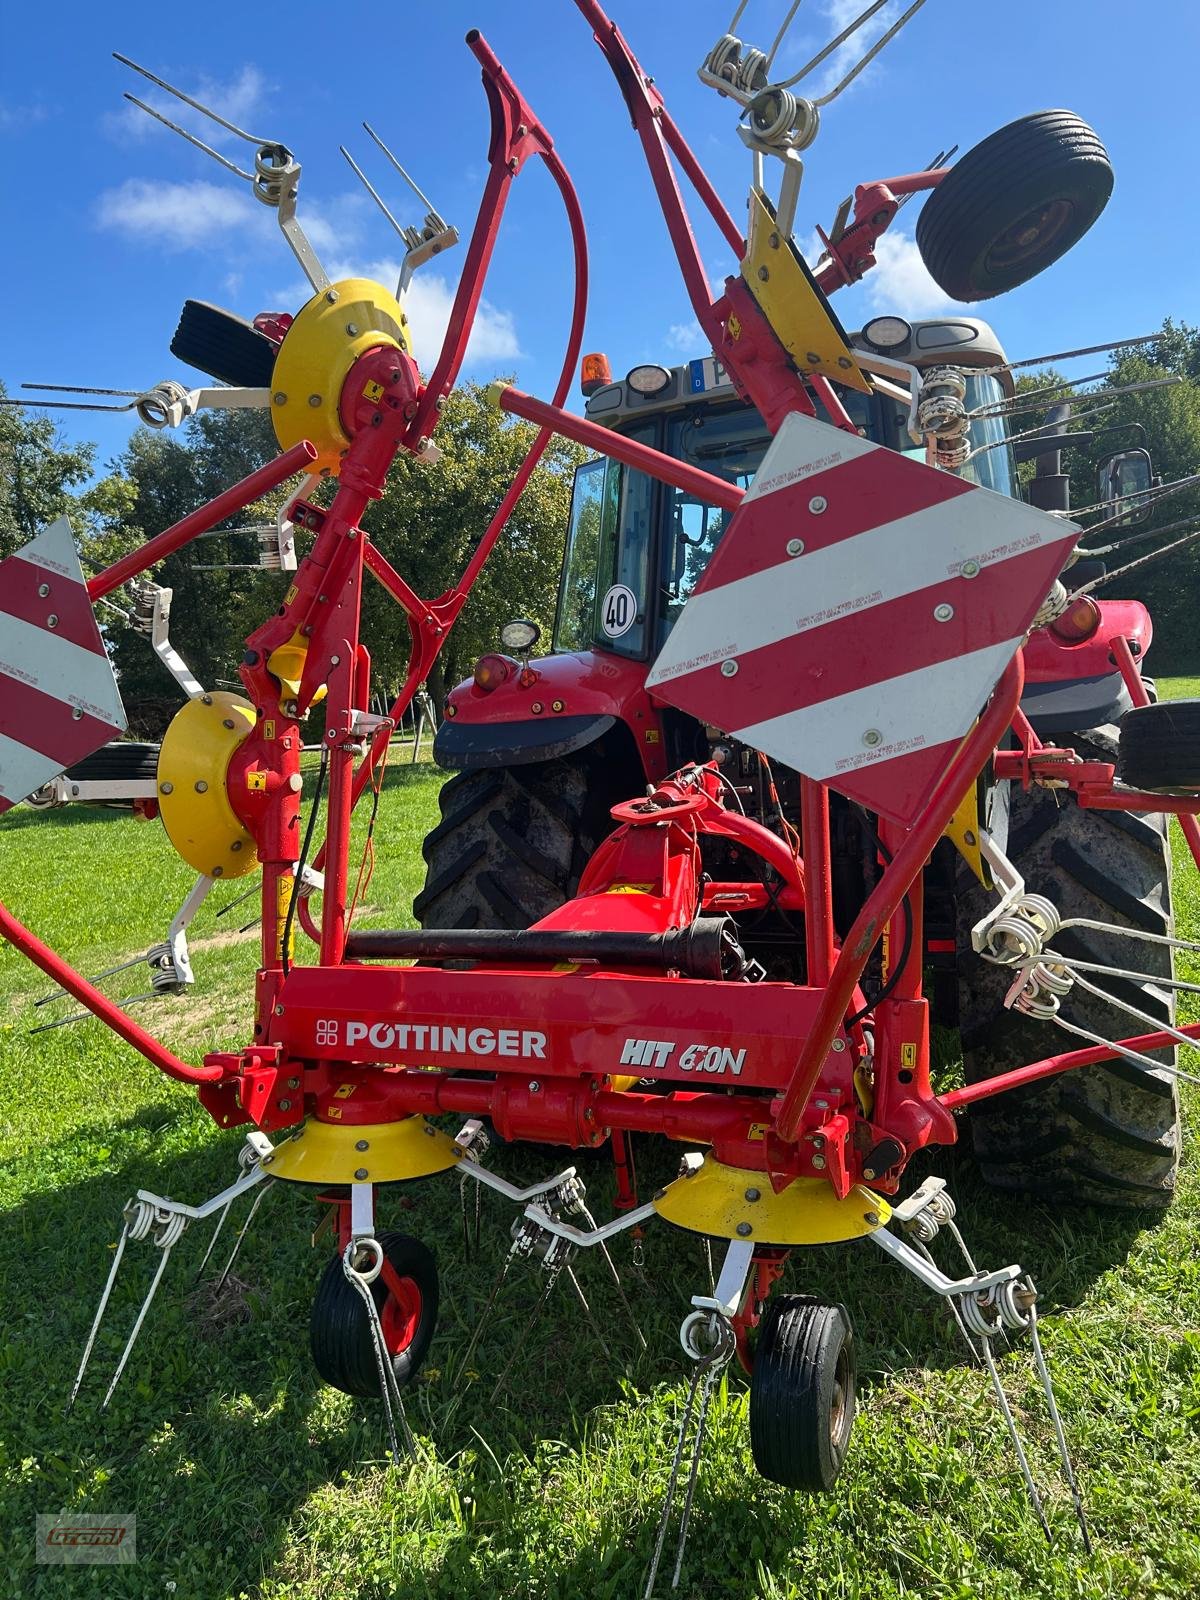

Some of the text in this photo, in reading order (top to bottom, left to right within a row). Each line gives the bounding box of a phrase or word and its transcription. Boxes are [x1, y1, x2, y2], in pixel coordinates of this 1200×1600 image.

[606, 593, 628, 628] 40
[346, 1021, 547, 1059] PÖTTINGER
[619, 1038, 676, 1068] HIT
